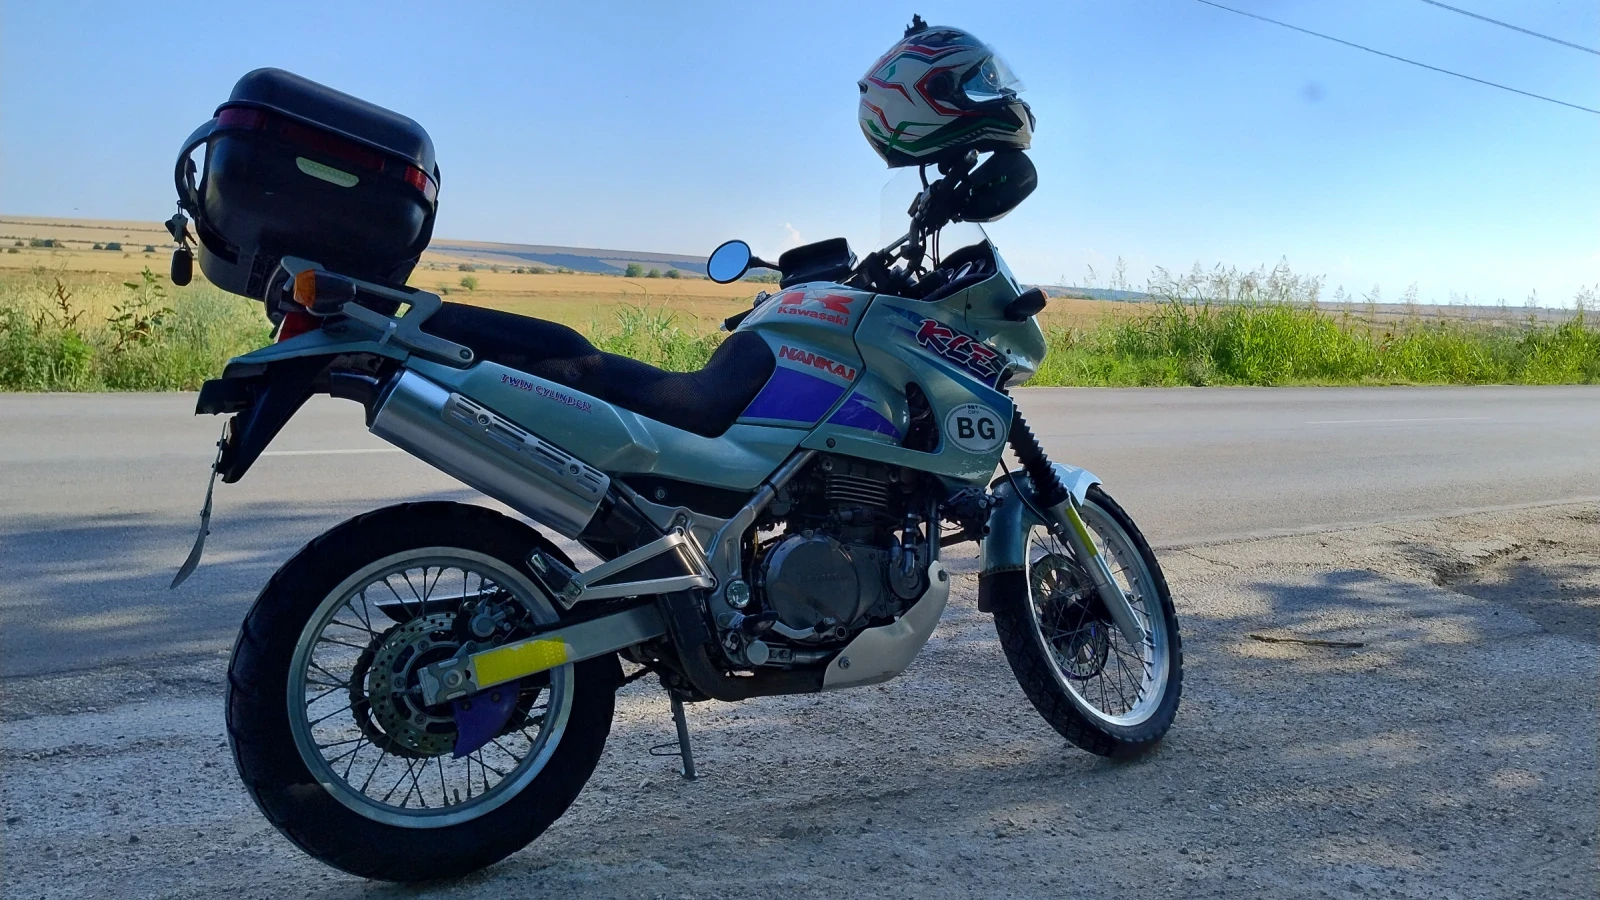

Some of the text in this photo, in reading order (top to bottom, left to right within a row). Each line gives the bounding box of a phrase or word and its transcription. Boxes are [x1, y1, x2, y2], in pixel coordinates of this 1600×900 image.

[777, 306, 849, 327] Kawasaki
[778, 345, 856, 382] NANKAI
[916, 319, 999, 378] KLE
[501, 373, 592, 414] TWIN CYLINDER
[956, 416, 996, 440] BG
